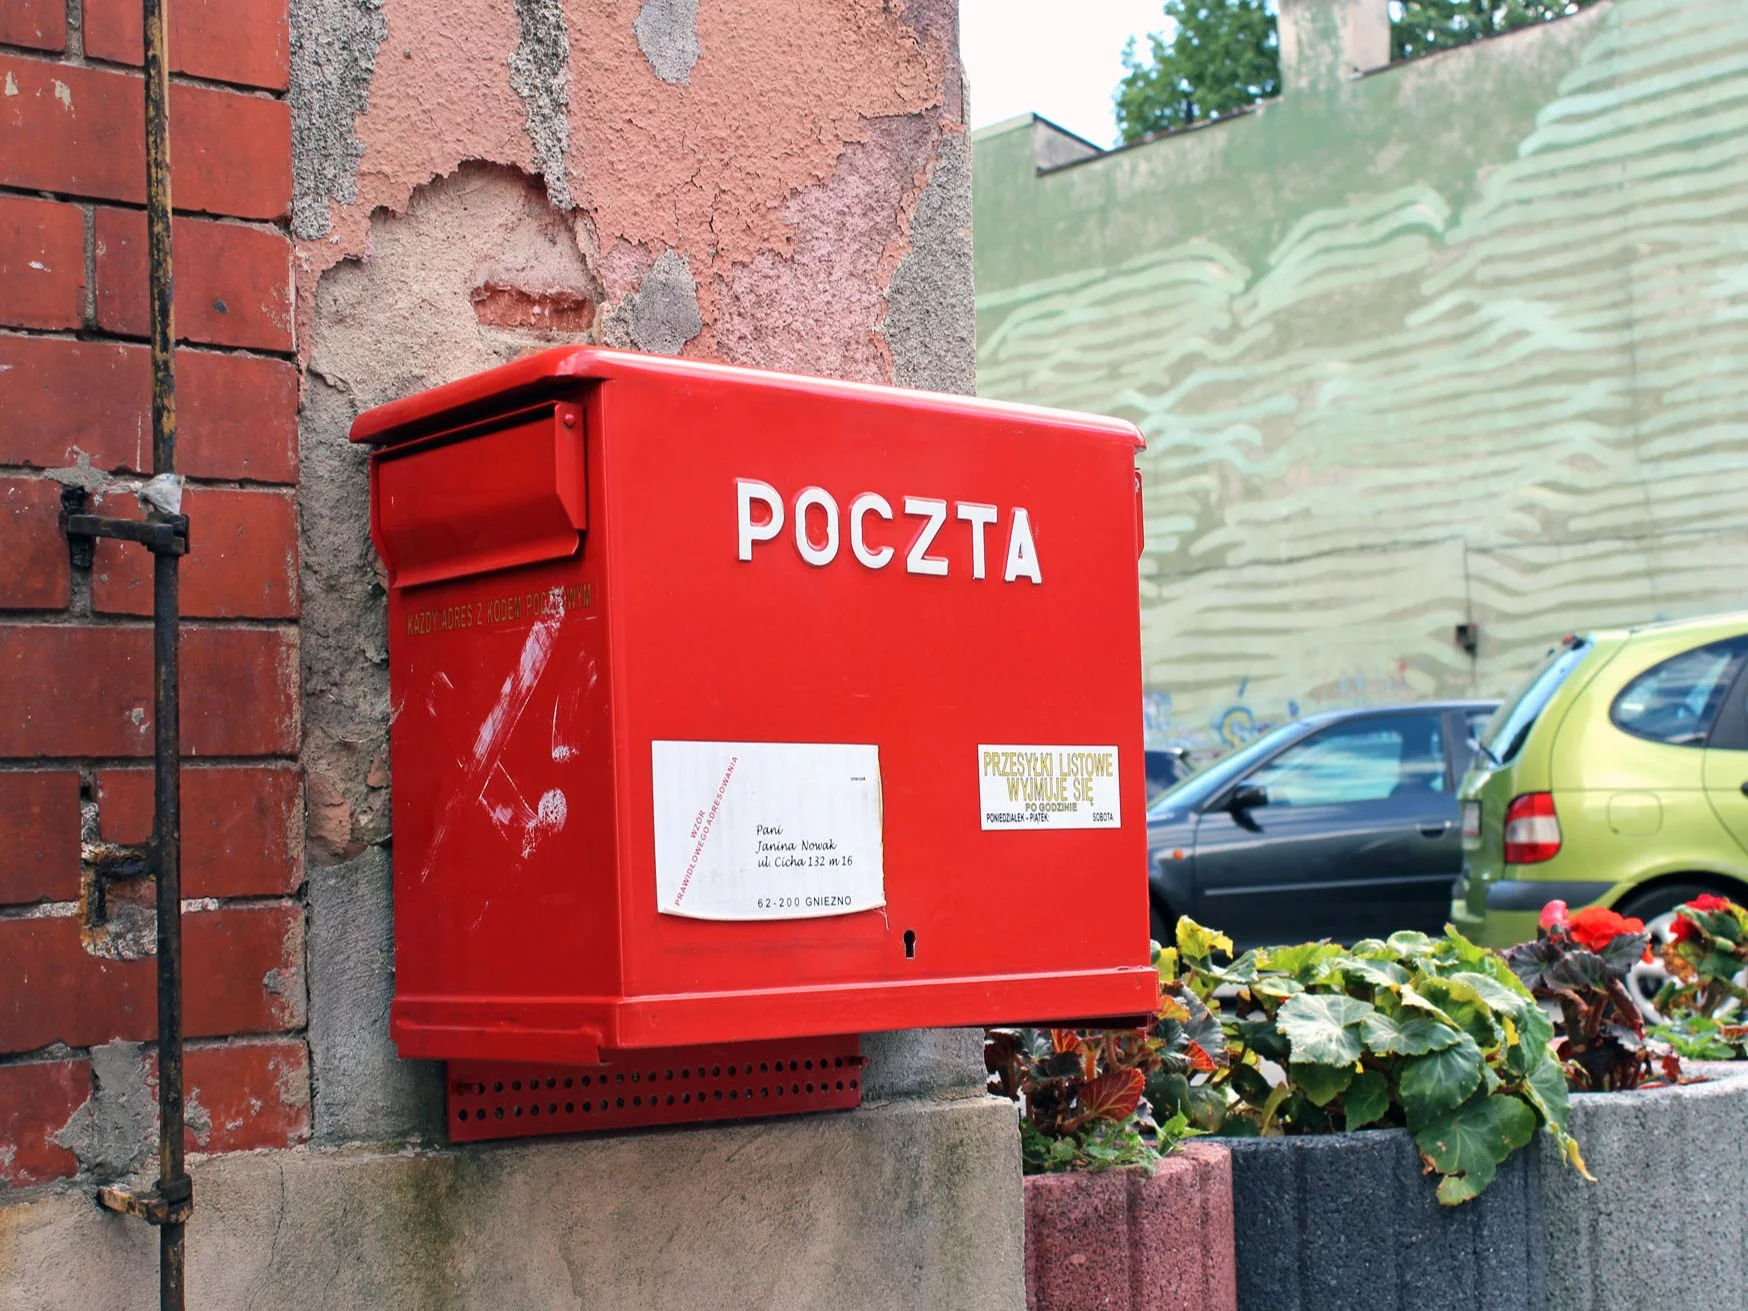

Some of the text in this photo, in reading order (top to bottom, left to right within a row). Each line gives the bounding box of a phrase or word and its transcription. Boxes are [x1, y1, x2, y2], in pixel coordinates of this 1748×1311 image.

[735, 477, 1042, 584] POCZTA
[442, 604, 473, 630] ADRES
[477, 602, 482, 625] Z
[487, 596, 521, 623] KODEM
[983, 751, 1113, 777] PRZESYŁKI LISTOWE
[1006, 777, 1094, 807] WYJMUJE SIĘ
[1025, 802, 1078, 812] PO GODZINIE
[756, 824, 783, 836] Pani
[755, 838, 837, 854] Janina Nowak
[757, 855, 853, 868] ul. Cicha 132 m 16
[757, 895, 852, 909] 62-200 GNIEZNO
